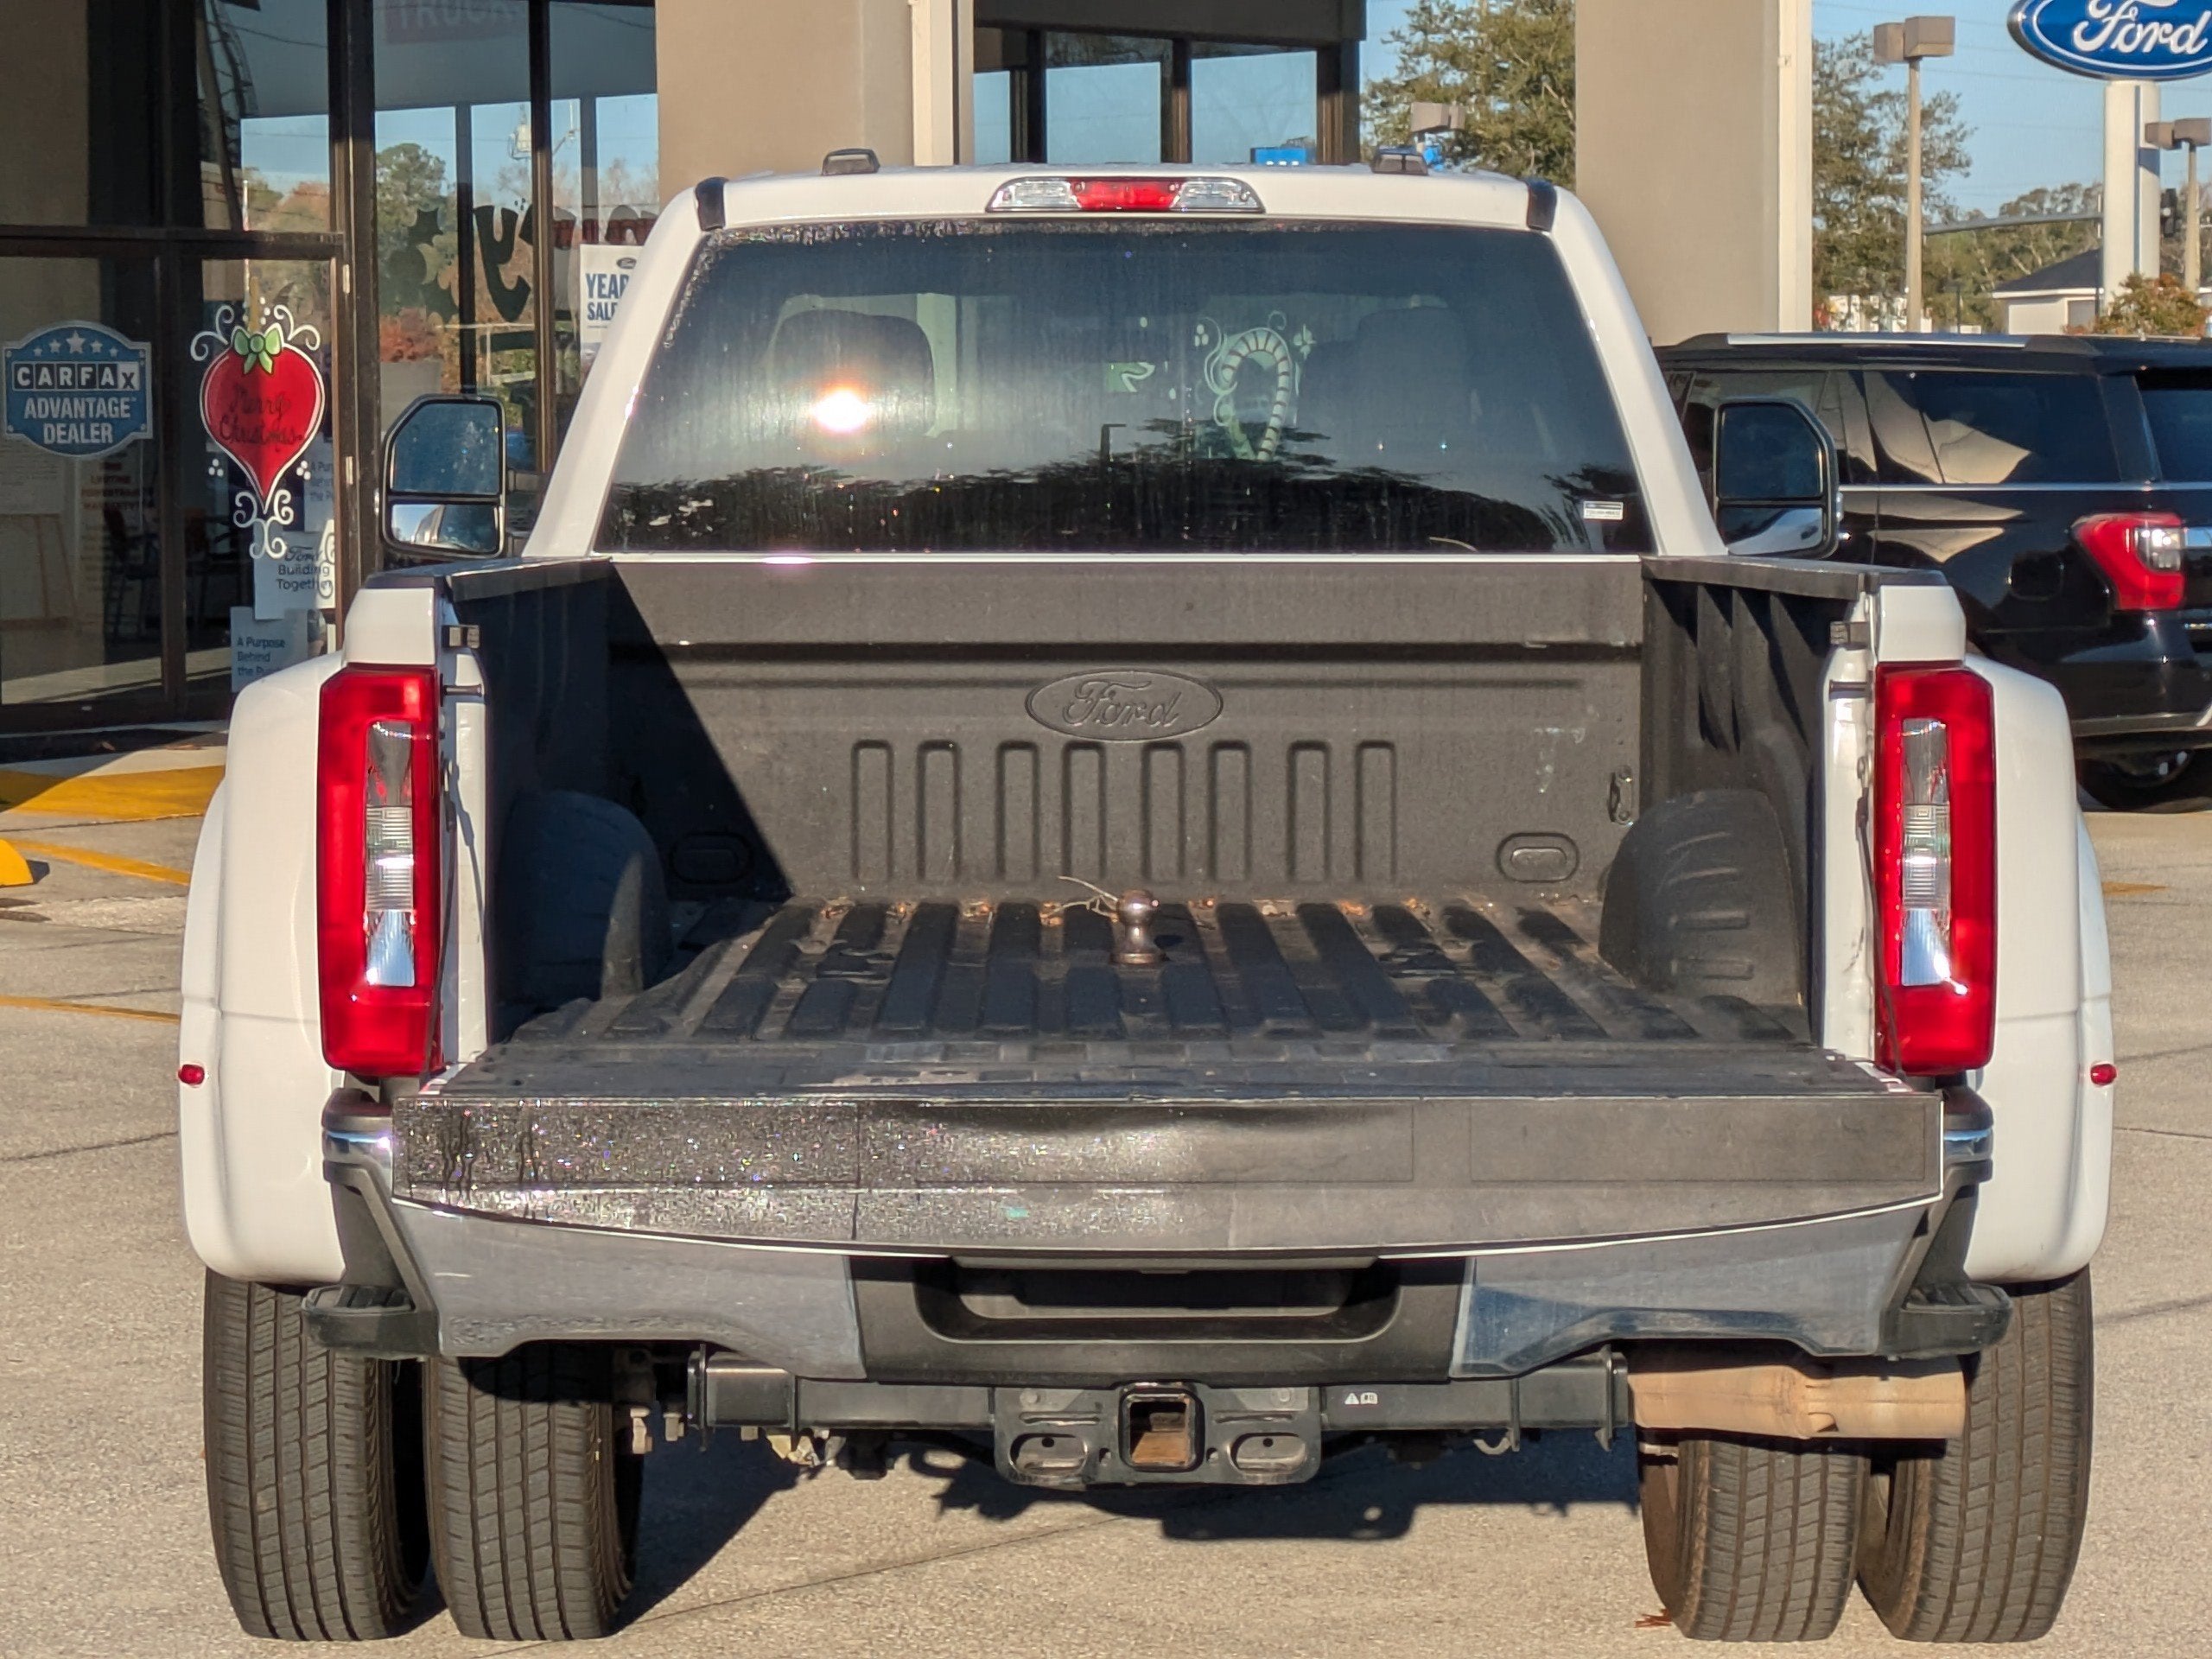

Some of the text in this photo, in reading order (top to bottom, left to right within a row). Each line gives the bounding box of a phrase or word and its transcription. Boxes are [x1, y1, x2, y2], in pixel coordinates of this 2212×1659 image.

[2074, 0, 2209, 54] Ford
[16, 365, 135, 390] CARFAX
[23, 396, 131, 420] ADVANTAGE
[43, 422, 113, 444] DEALER
[277, 564, 330, 577] Building
[1062, 680, 1182, 728] Ford
